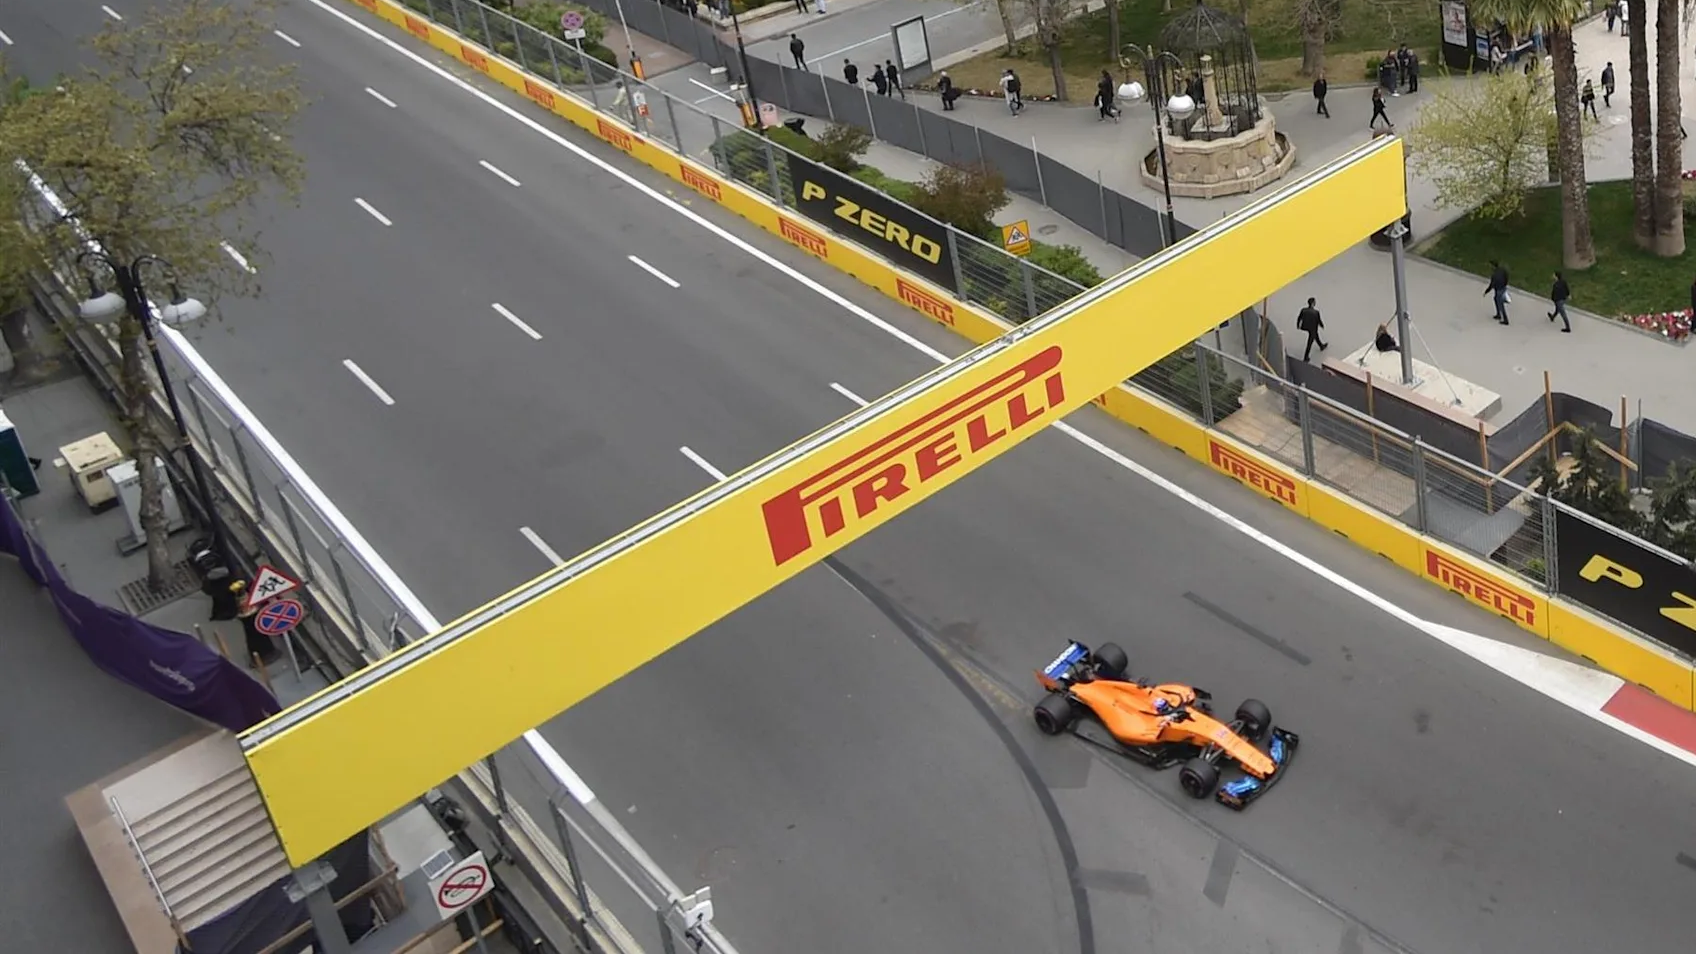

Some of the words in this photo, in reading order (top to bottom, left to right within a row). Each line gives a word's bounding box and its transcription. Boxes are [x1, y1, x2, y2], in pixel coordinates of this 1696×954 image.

[596, 119, 632, 151] PIRELLI
[680, 164, 721, 201] PIRELLI
[778, 217, 827, 258] PIRELLI
[802, 180, 826, 201] P
[834, 195, 941, 264] ZERO
[896, 278, 954, 326] PIRELLI
[762, 345, 1065, 566] PIRELLI
[1210, 440, 1296, 505] PIRELLI
[1426, 549, 1535, 626] PIRELLI
[1579, 553, 1643, 590] P
